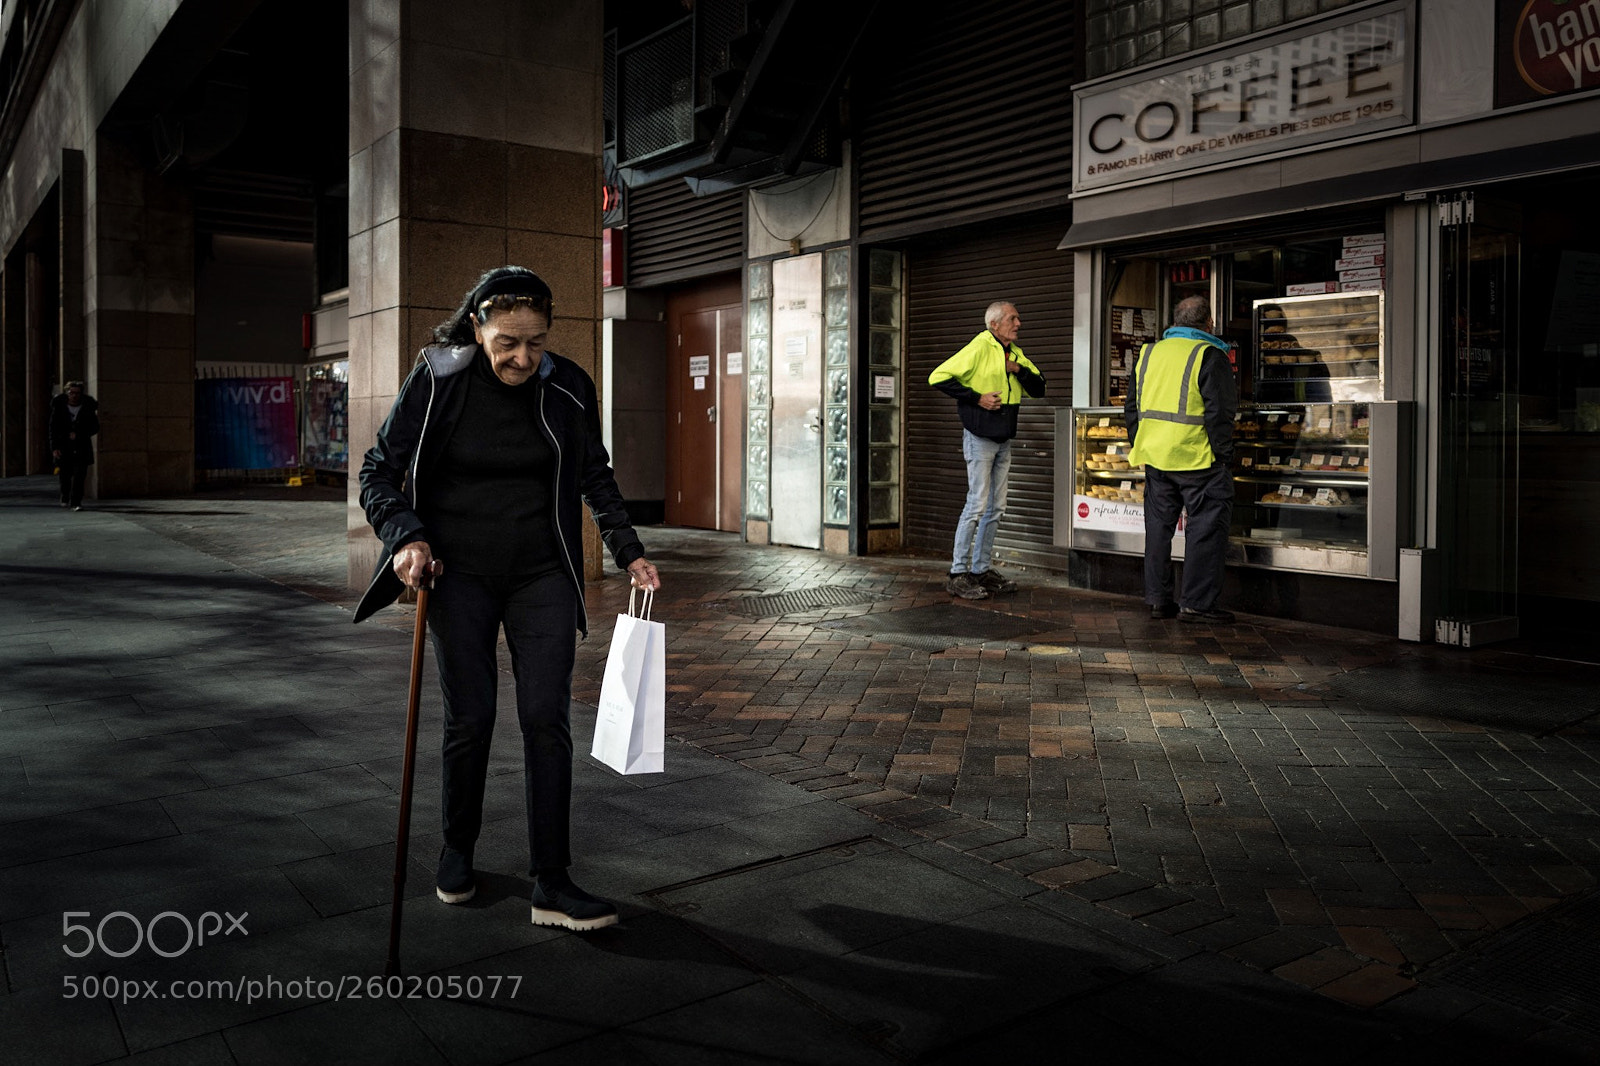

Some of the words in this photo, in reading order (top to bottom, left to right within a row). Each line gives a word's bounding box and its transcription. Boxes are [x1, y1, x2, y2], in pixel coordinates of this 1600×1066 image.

[1088, 40, 1394, 154] COFFEE
[1187, 70, 1217, 85] THE
[1222, 58, 1263, 77] BEST
[1087, 165, 1096, 175] &
[1097, 157, 1138, 174] FAMOUS
[1139, 149, 1175, 165] HARRY
[1208, 137, 1225, 150] DE
[1227, 126, 1278, 145] WHEELS
[1280, 120, 1309, 135] PIES
[1356, 100, 1394, 118] 1945
[1093, 503, 1119, 517] refresh
